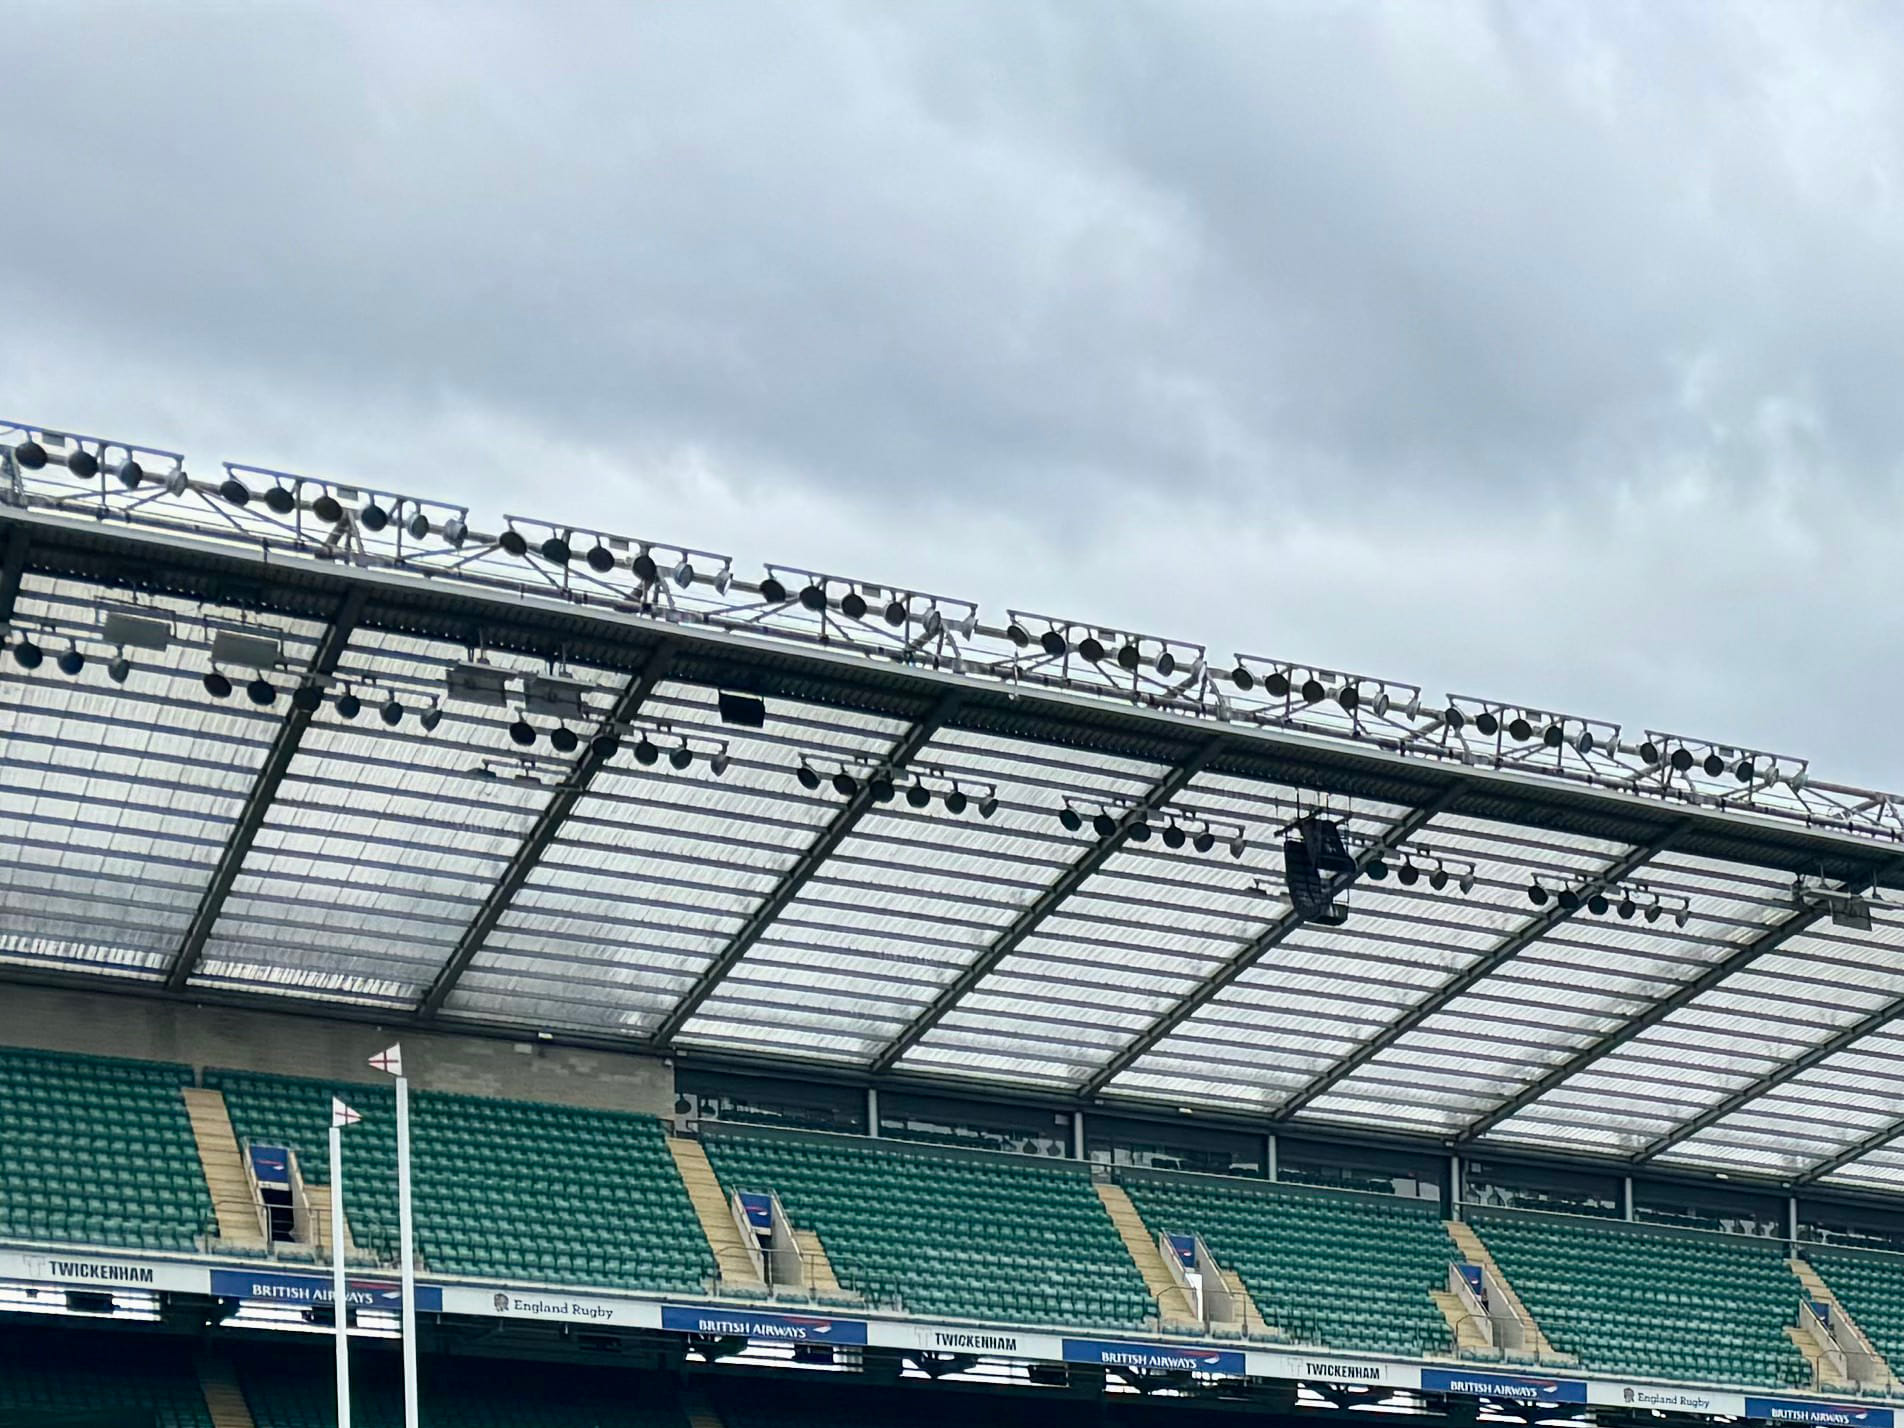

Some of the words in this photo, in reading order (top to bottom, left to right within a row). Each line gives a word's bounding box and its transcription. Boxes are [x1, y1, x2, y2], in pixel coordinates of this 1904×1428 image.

[49, 1260, 154, 1283] TWICKENHAM
[252, 1284, 310, 1300] BRITISH
[313, 1288, 374, 1305] AIRAYS
[513, 1299, 569, 1316] England
[572, 1303, 614, 1320] Rugby
[698, 1319, 750, 1335] BRITISH
[754, 1322, 807, 1339] AIRWAYS
[935, 1332, 1017, 1351] TWICKENHAM
[1101, 1351, 1147, 1366] BRITISH
[1149, 1354, 1198, 1369] AIRWAYS
[1306, 1362, 1380, 1380] TWICKENHAM
[1450, 1380, 1491, 1394] BRITISH
[1493, 1383, 1538, 1398] AIRWAYS
[1638, 1392, 1677, 1407] England
[1680, 1394, 1710, 1410] Rugby
[1771, 1408, 1808, 1421] BRITISH
[1810, 1411, 1850, 1424] AIRWAYS
